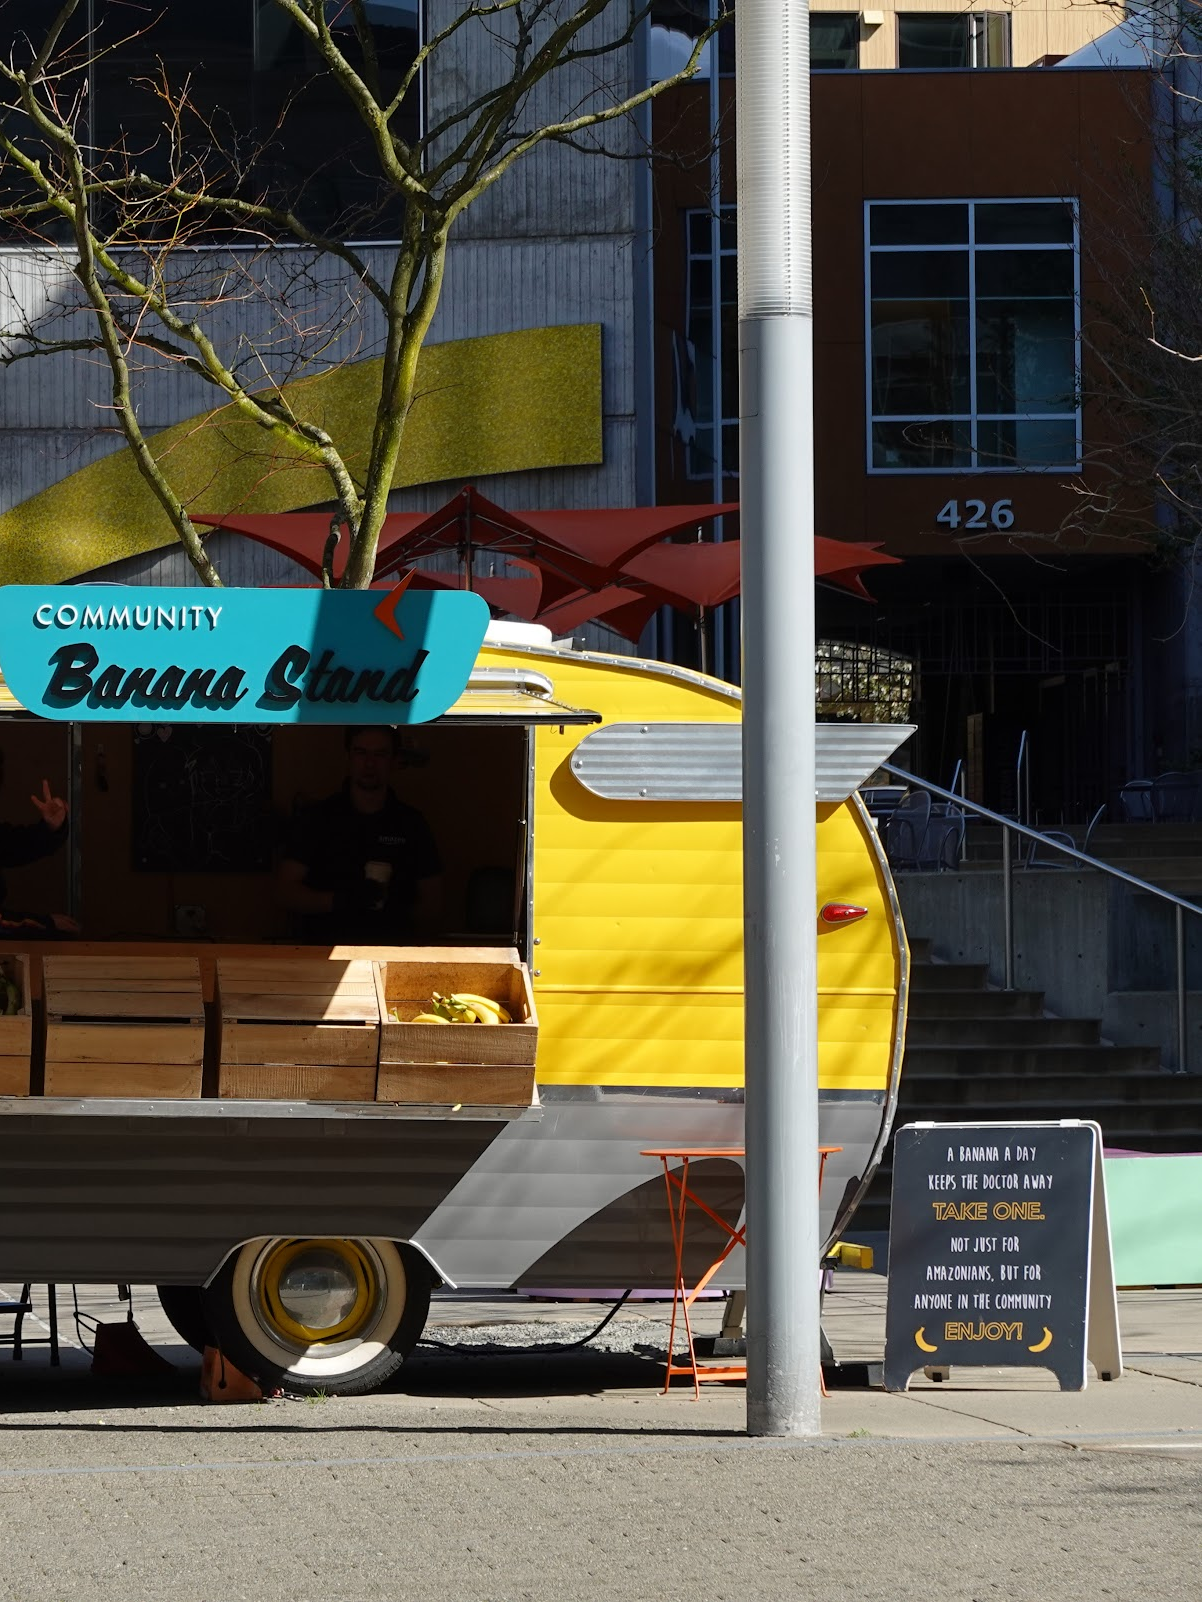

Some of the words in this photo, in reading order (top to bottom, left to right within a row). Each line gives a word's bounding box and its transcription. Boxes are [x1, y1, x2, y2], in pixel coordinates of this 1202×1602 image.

[936, 499, 1015, 529] 426
[34, 604, 223, 630] COMMUNITY
[41, 642, 248, 710] Banana
[255, 644, 430, 708] Stand
[947, 1146, 954, 1162] A
[959, 1145, 999, 1162] BANANA
[1004, 1146, 1011, 1162] A
[1016, 1146, 1036, 1161] DAY
[928, 1174, 957, 1190] KEEPS
[961, 1175, 978, 1190] THE
[983, 1174, 1019, 1190] DOCTOR
[1023, 1174, 1053, 1190] AWAY
[932, 1202, 988, 1221] TAKE
[992, 1202, 1045, 1220] ONE.
[950, 1237, 970, 1252] NOT
[973, 1237, 997, 1252] JUST
[1002, 1236, 1020, 1252] FOR
[926, 1265, 994, 1282] AMAZONIANS,
[1000, 1265, 1019, 1281] BUT
[1024, 1264, 1041, 1281] FOR
[914, 1294, 953, 1310] ANYONE
[957, 1294, 968, 1309] IN
[973, 1294, 990, 1309] THE
[995, 1294, 1052, 1310] COMMUNITY
[944, 1321, 1023, 1341] ENJOY!
